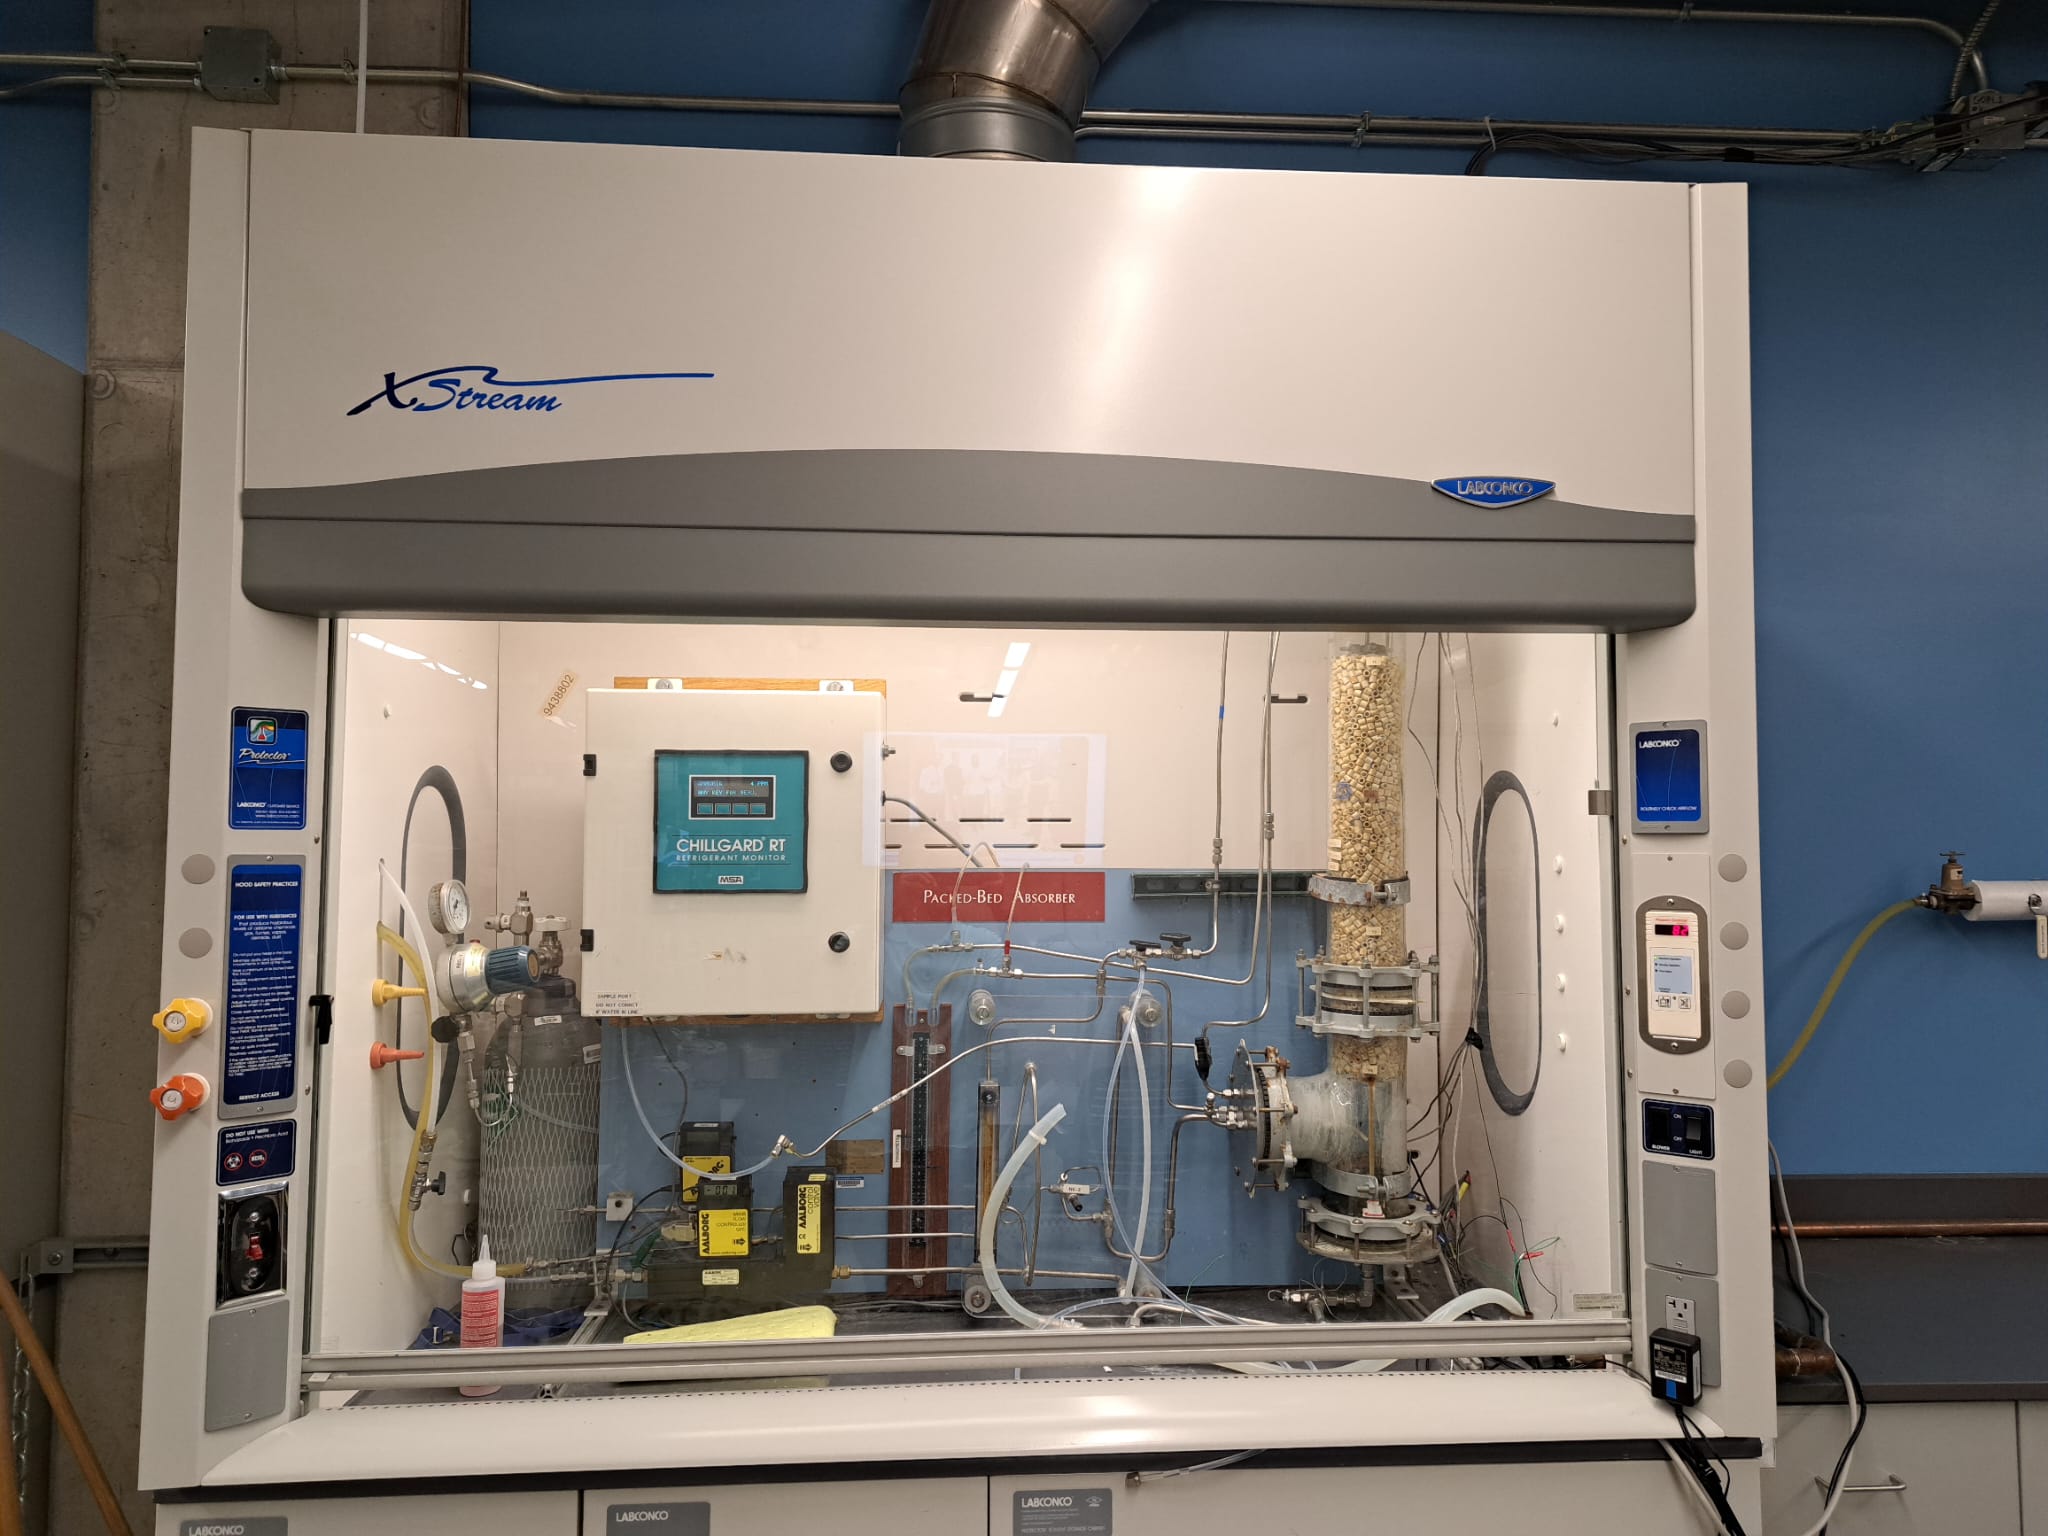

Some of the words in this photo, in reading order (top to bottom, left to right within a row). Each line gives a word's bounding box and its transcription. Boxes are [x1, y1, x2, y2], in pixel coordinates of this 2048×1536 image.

[1457, 480, 1534, 496] LABCONCO
[543, 674, 575, 716] 9438802
[1639, 739, 1680, 748] LABCONCO
[239, 748, 288, 760] Protector
[676, 838, 764, 853] CHILLGARD
[769, 838, 786, 851] RT
[676, 854, 738, 862] REFRIGERANT
[719, 876, 742, 884] MSA
[1014, 890, 1076, 904] ABSORBER
[1672, 925, 1689, 936] 82
[239, 1093, 260, 1101] SERVICE
[798, 1187, 807, 1229] AALBORG
[701, 1213, 710, 1254] AALBORG
[1021, 1496, 1073, 1508] LABCONCO
[615, 1510, 669, 1522] LABCONCO
[188, 1524, 244, 1536] LABCONCO
